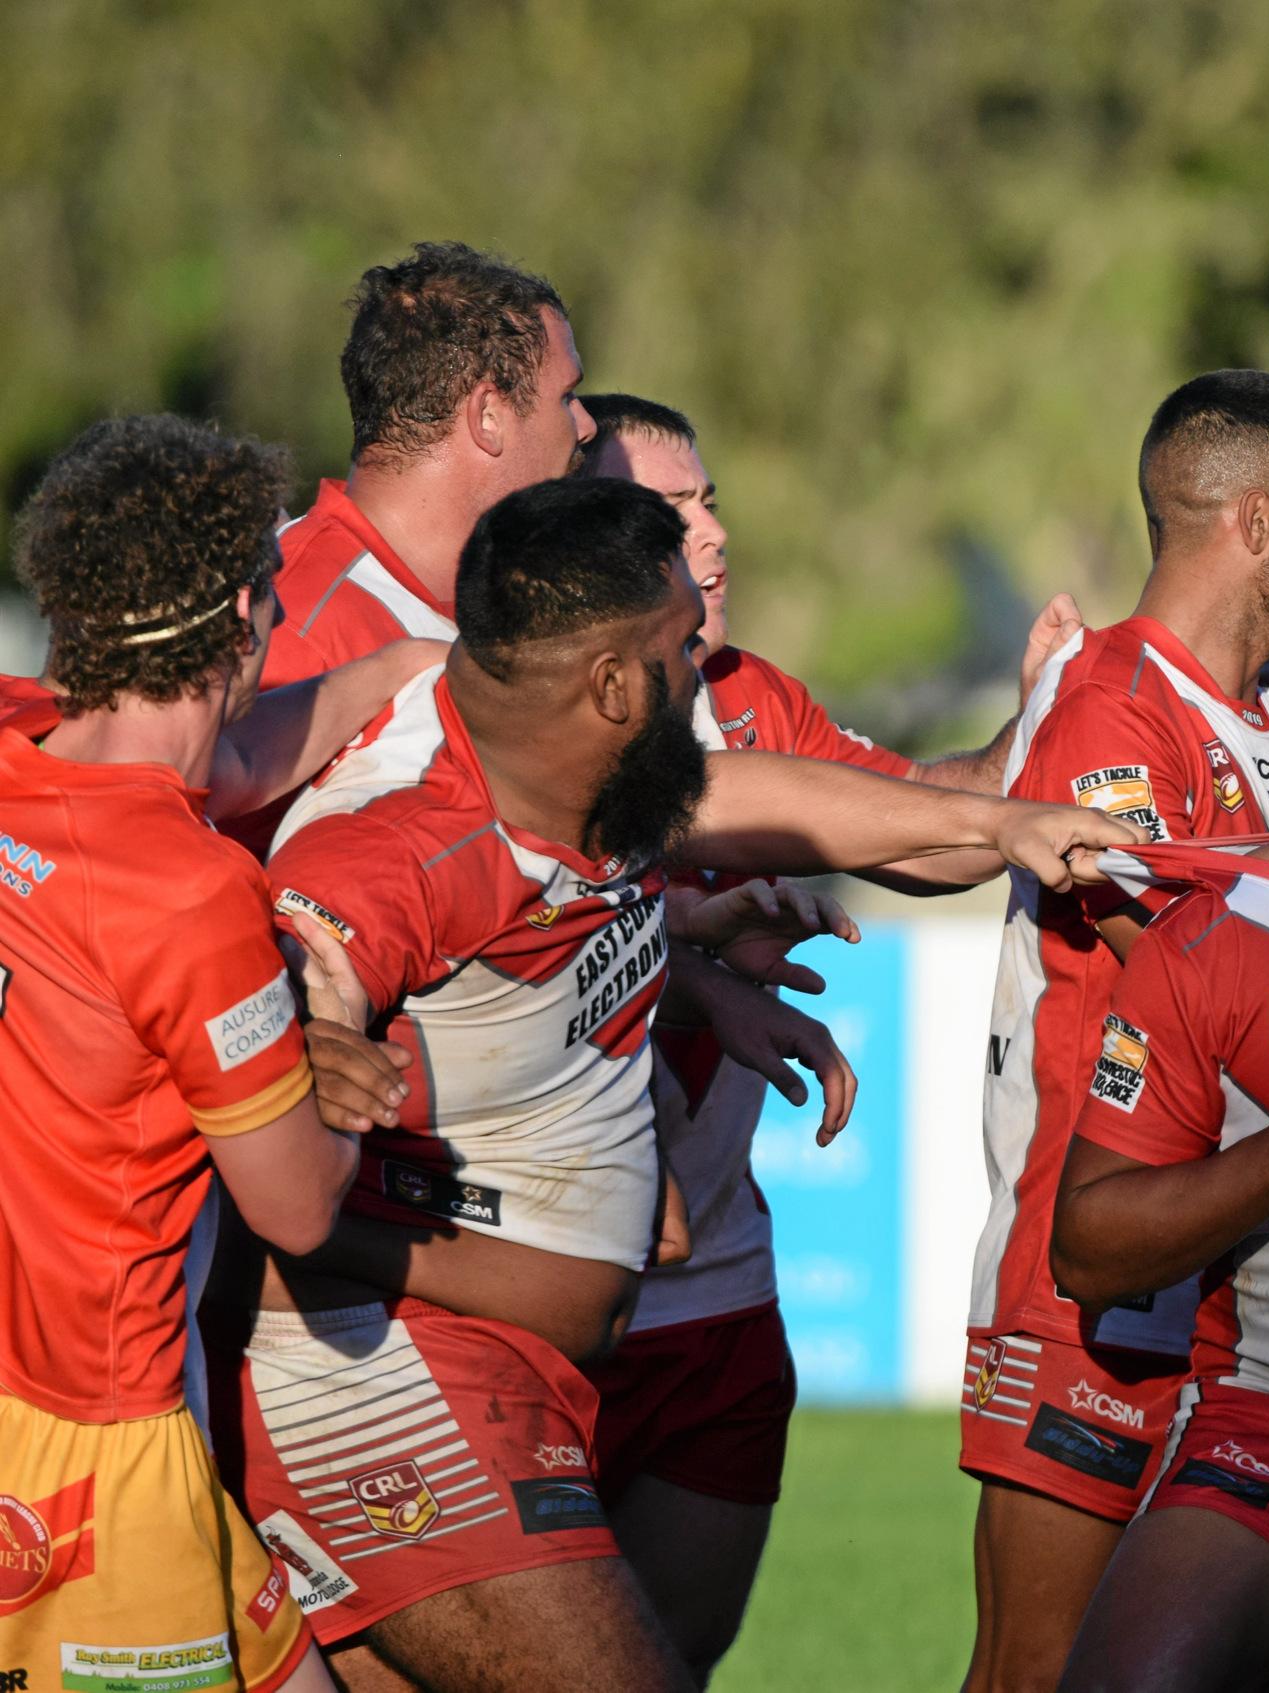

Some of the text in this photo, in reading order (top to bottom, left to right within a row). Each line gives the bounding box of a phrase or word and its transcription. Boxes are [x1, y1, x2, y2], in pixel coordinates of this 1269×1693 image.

[1102, 766, 1142, 782] TACKLE
[575, 924, 620, 1000] EAST
[222, 984, 279, 1037] AUSURE
[449, 1199, 493, 1220] CSM
[1093, 1391, 1146, 1430] CSM
[359, 1471, 418, 1501] CRL
[100, 1650, 137, 1666] Smith
[137, 1640, 229, 1671] ELECTRICAL
[143, 1681, 171, 1693] 0408
